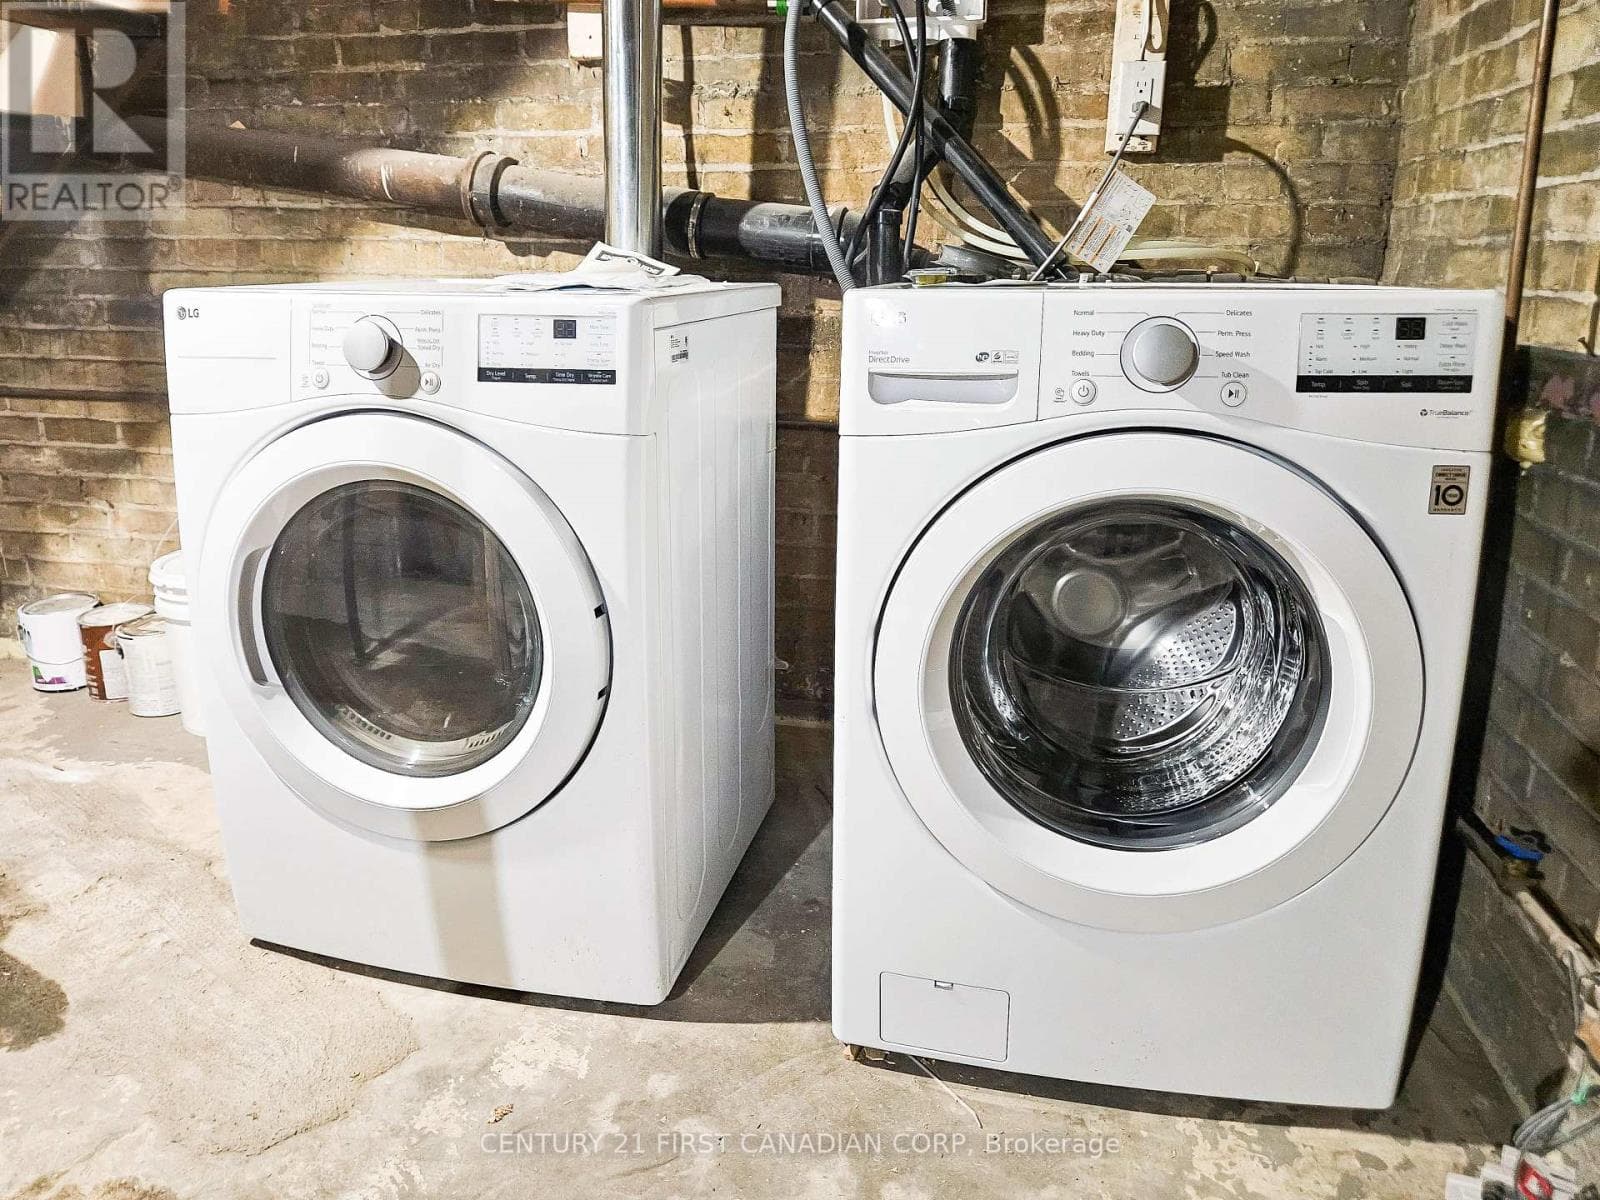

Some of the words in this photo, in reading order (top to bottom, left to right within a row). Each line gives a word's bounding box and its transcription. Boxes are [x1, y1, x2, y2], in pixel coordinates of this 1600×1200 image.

[188, 308, 199, 318] LG
[1073, 309, 1095, 317] Normal
[1225, 309, 1253, 317] Delicates
[1072, 329, 1089, 337] Heavy
[1090, 329, 1105, 338] Duty
[1235, 330, 1252, 338] Press
[1071, 350, 1095, 358] Bedding
[1215, 350, 1231, 359] Speed
[1233, 371, 1250, 379] Clean
[1434, 485, 1464, 506] 10
